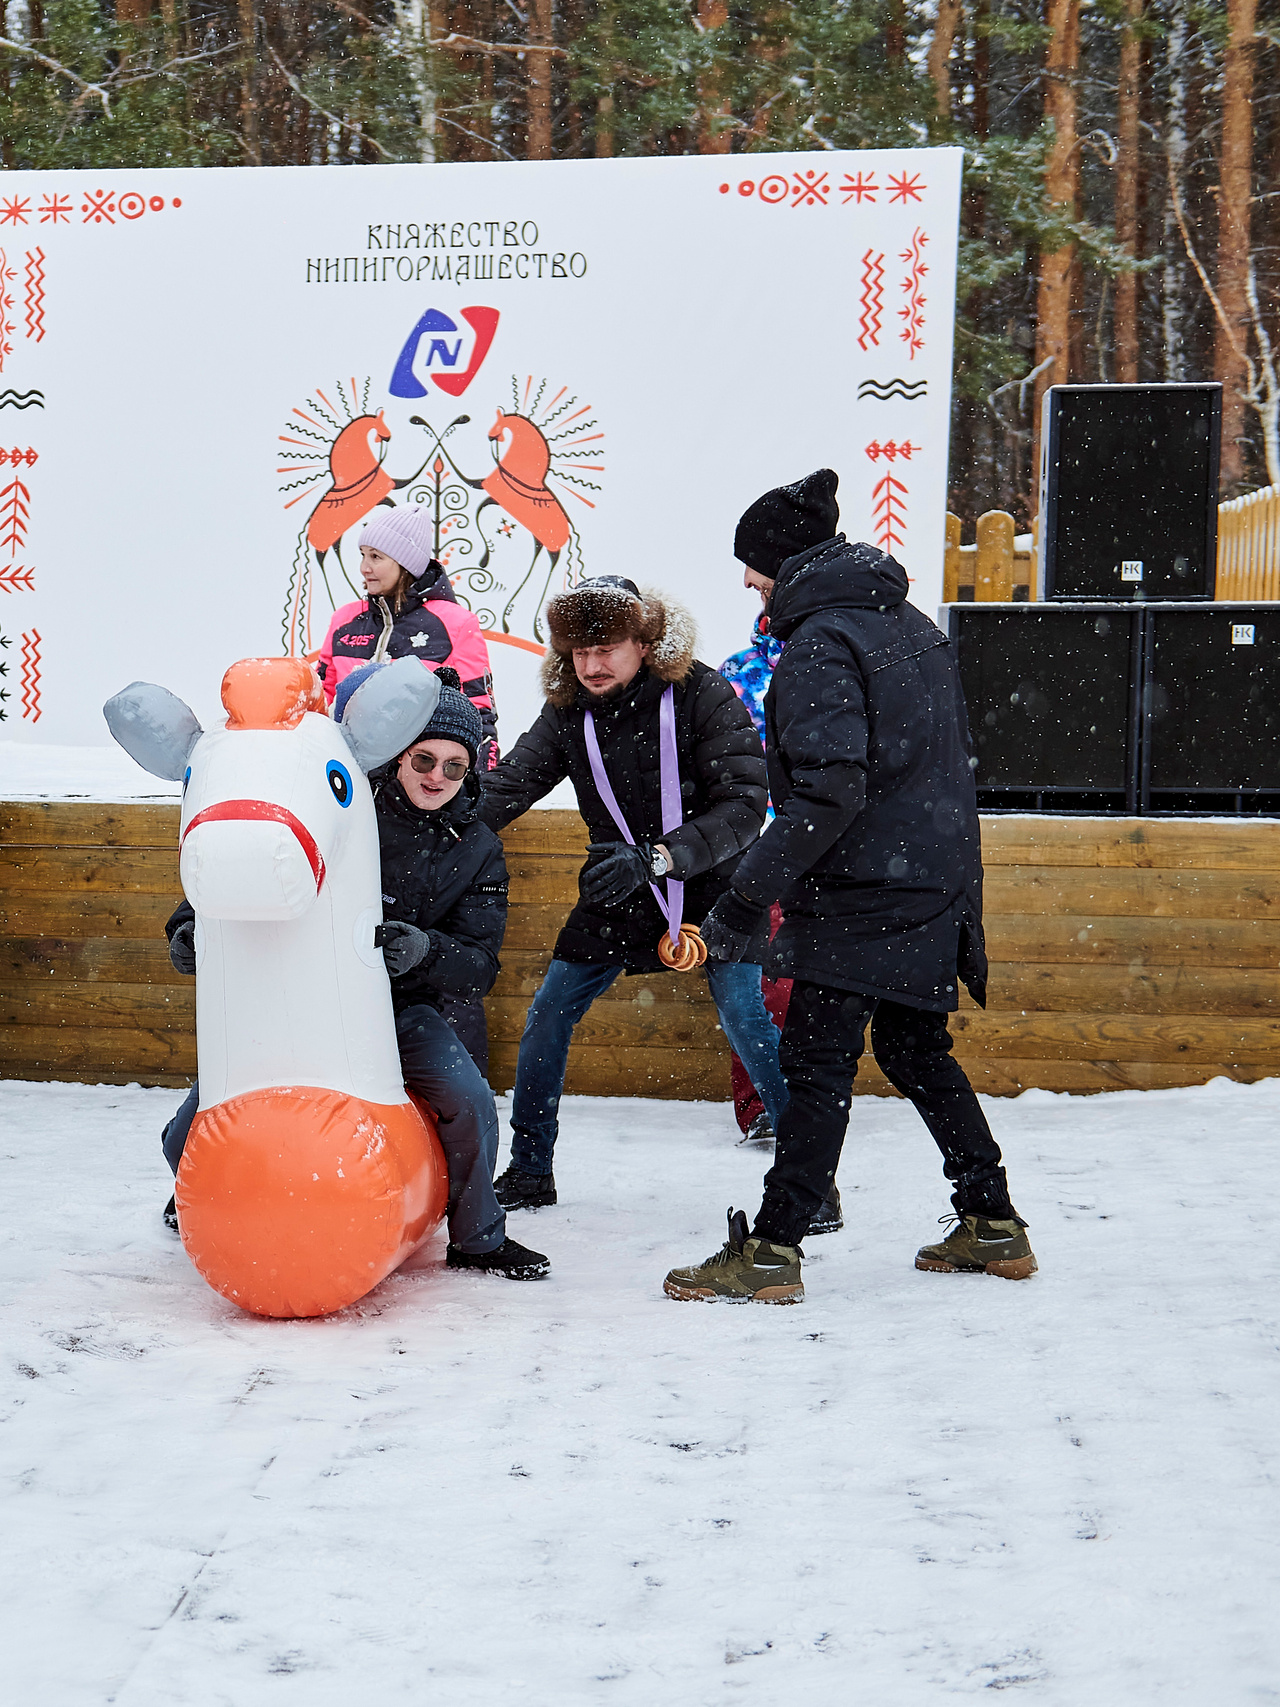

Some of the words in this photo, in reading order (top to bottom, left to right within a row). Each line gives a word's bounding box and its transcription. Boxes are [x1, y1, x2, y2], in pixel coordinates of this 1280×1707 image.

[367, 220, 539, 249] КНЯЖЕСТВО
[306, 252, 587, 285] НИПИГОРМАШЕСТВО
[425, 338, 463, 366] N
[1124, 563, 1139, 574] HK
[1234, 627, 1251, 638] HK
